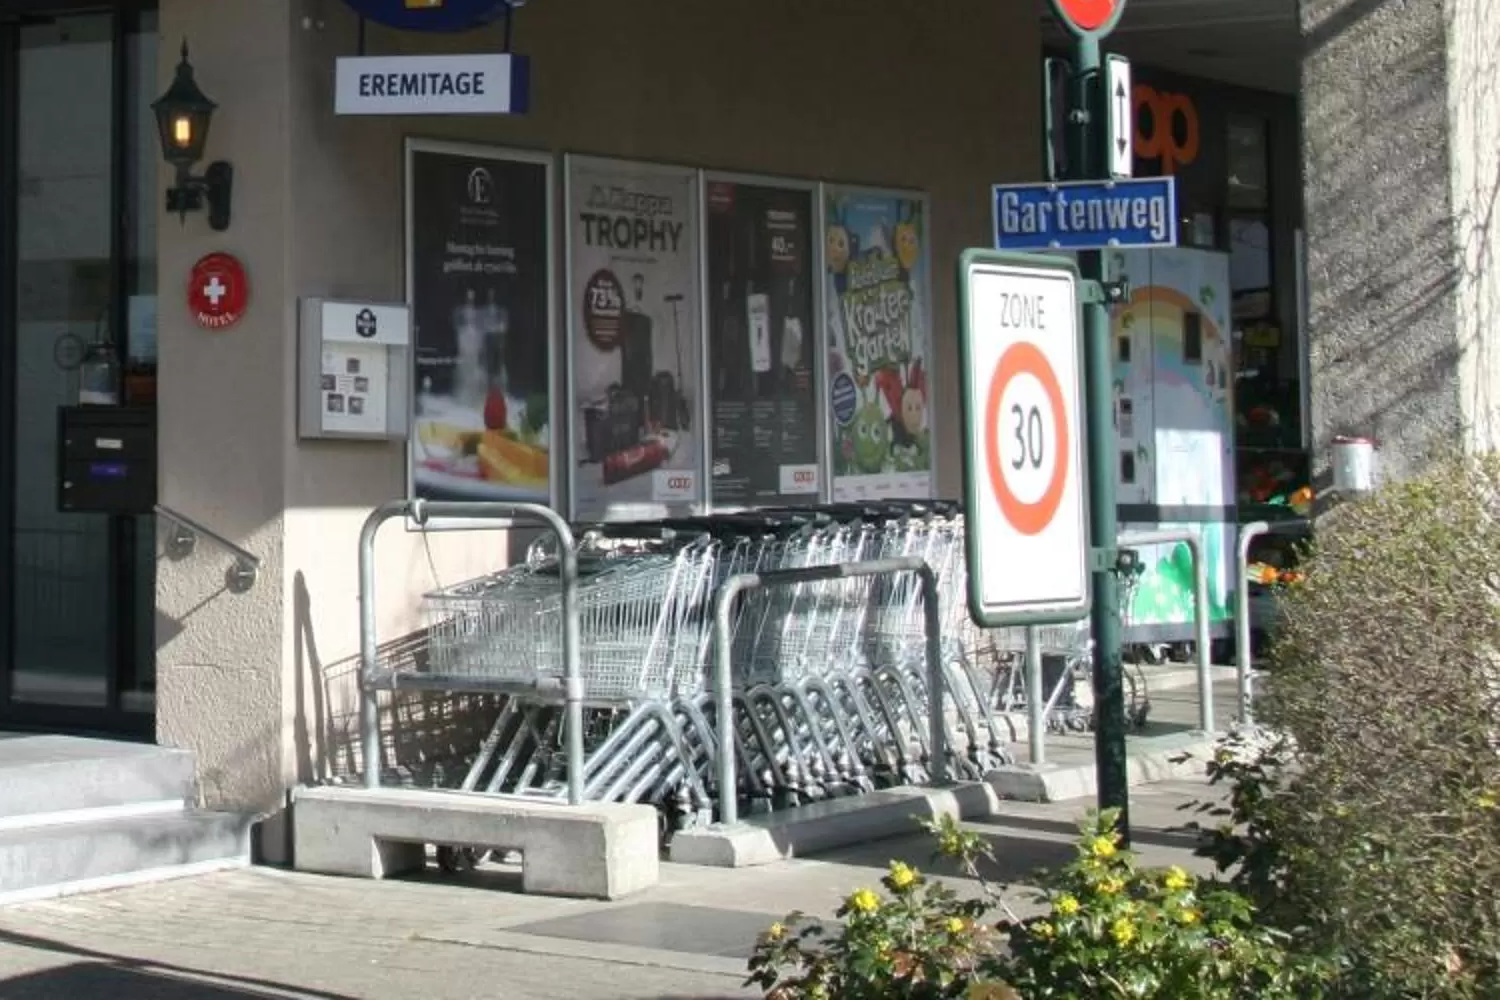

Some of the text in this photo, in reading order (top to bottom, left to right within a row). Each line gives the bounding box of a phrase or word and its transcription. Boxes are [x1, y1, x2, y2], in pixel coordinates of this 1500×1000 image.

[358, 71, 485, 98] EREMITAGE
[1132, 83, 1199, 178] op
[579, 212, 683, 253] TROPHY
[1001, 190, 1166, 241] Gartenweg
[999, 292, 1046, 330] ZONE
[1011, 402, 1044, 471] 30
